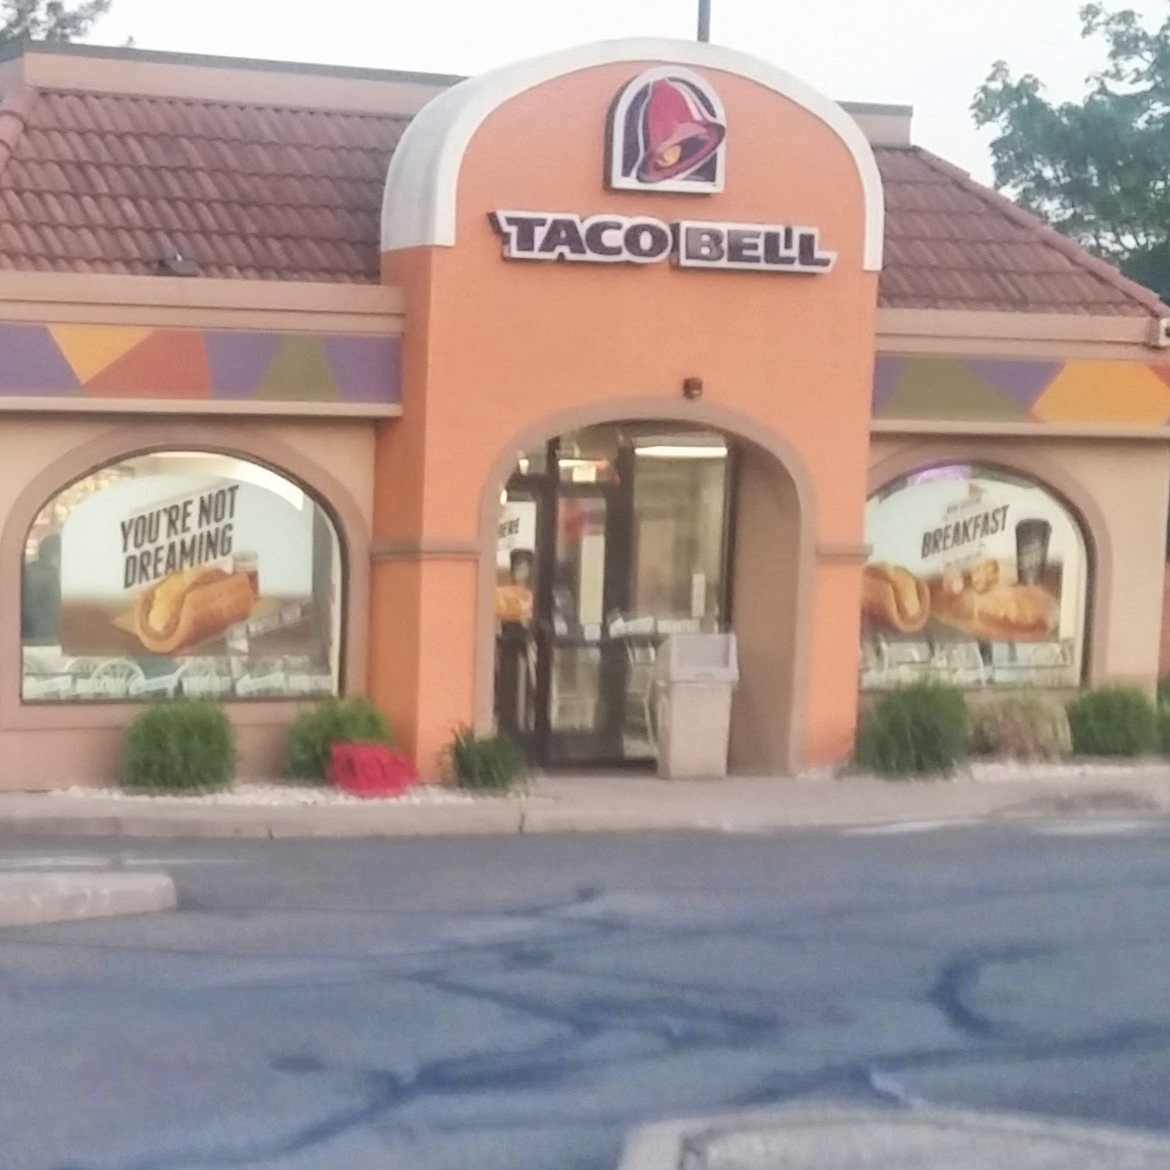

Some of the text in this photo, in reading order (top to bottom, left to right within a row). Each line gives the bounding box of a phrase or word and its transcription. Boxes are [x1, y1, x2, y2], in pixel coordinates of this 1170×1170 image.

[499, 213, 832, 268] TACO BELL
[120, 485, 239, 553] YOU'RE NOT
[921, 504, 1009, 559] BREAKFAST
[123, 523, 233, 589] DREAMING
